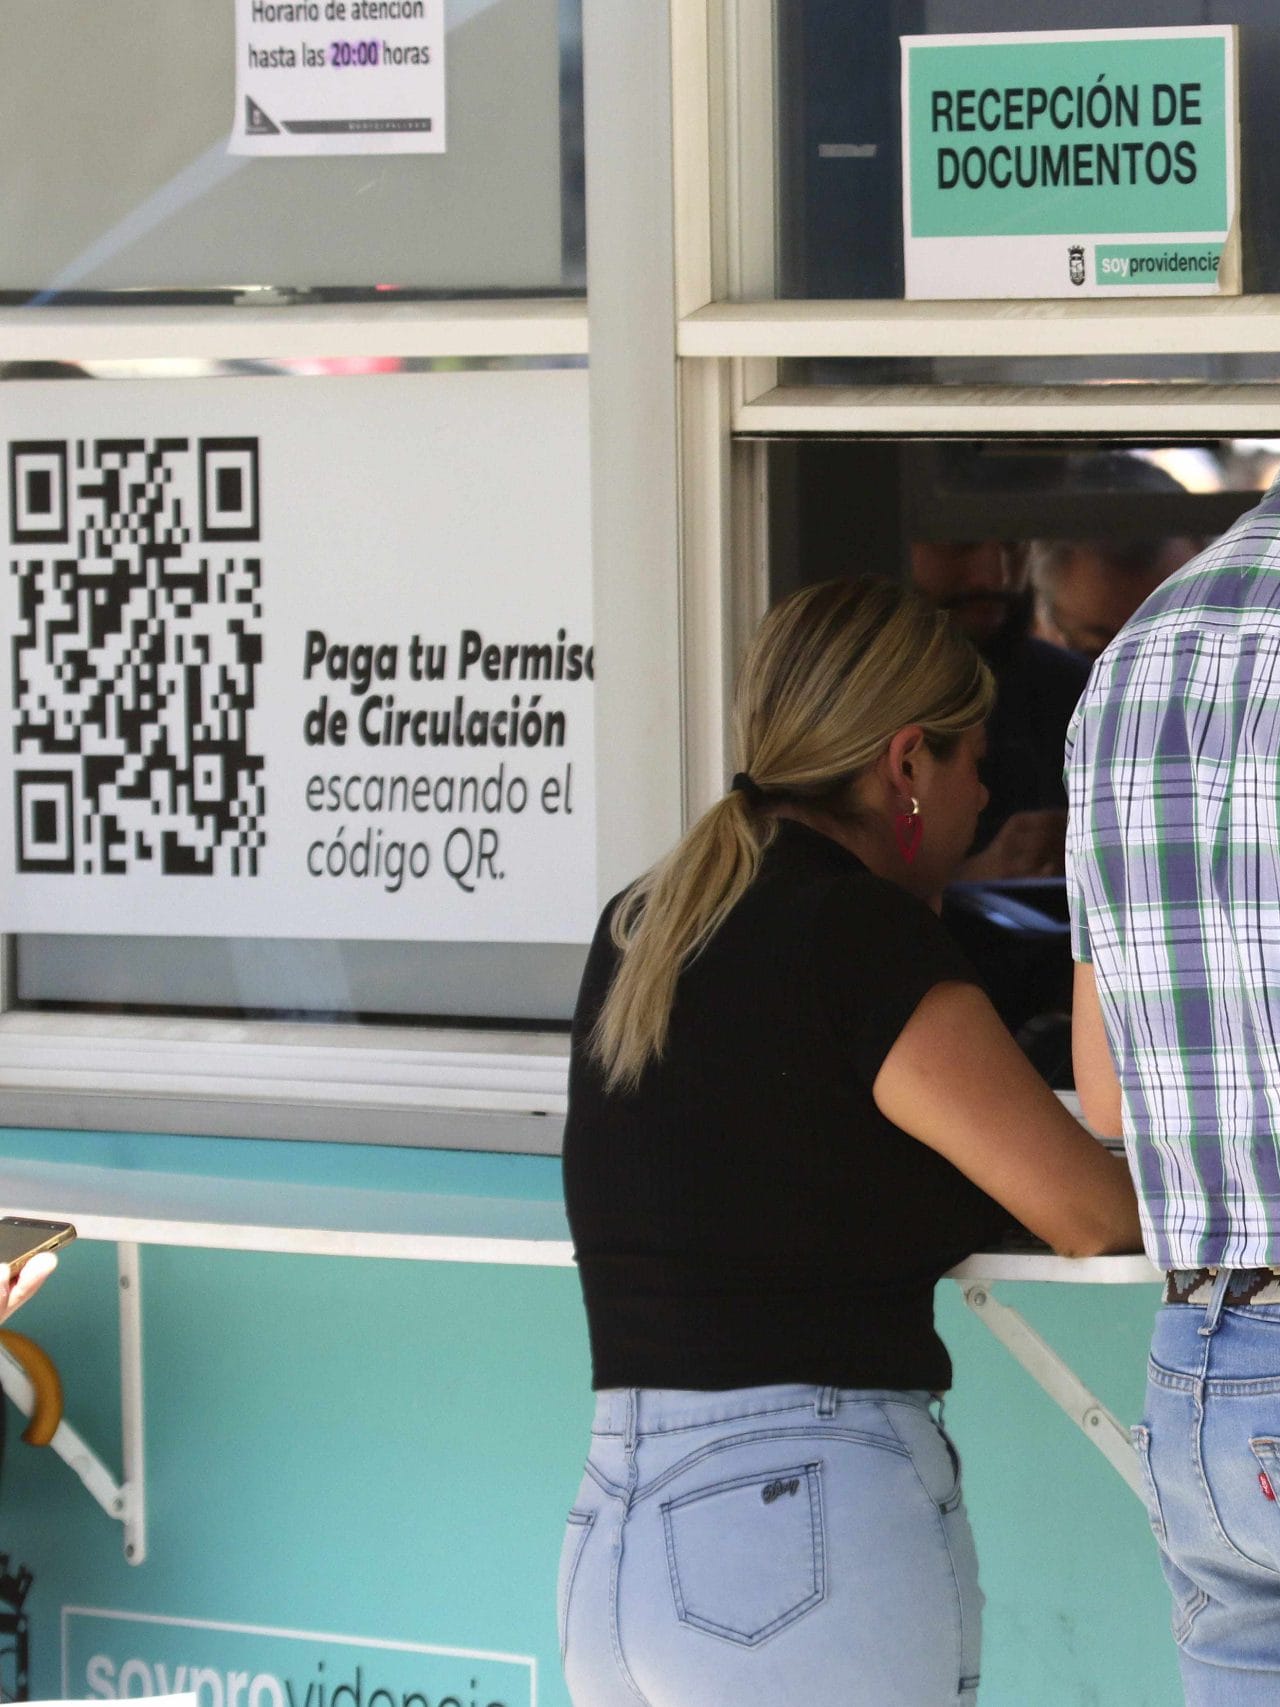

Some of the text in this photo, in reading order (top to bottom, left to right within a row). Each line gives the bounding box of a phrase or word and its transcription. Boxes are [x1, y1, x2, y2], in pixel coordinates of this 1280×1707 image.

[251, 0, 319, 23] Horario
[325, 0, 346, 21] de
[249, 40, 430, 68] hasta las 20:00 horas
[931, 73, 1202, 132] RECEPCIÓN DE
[937, 140, 1198, 190] DOCUMENTOS
[303, 630, 398, 696] Paga
[408, 635, 448, 682] tu
[303, 694, 566, 748] de Circulación
[305, 762, 573, 815] escaneando el
[307, 826, 506, 894] código QR.
